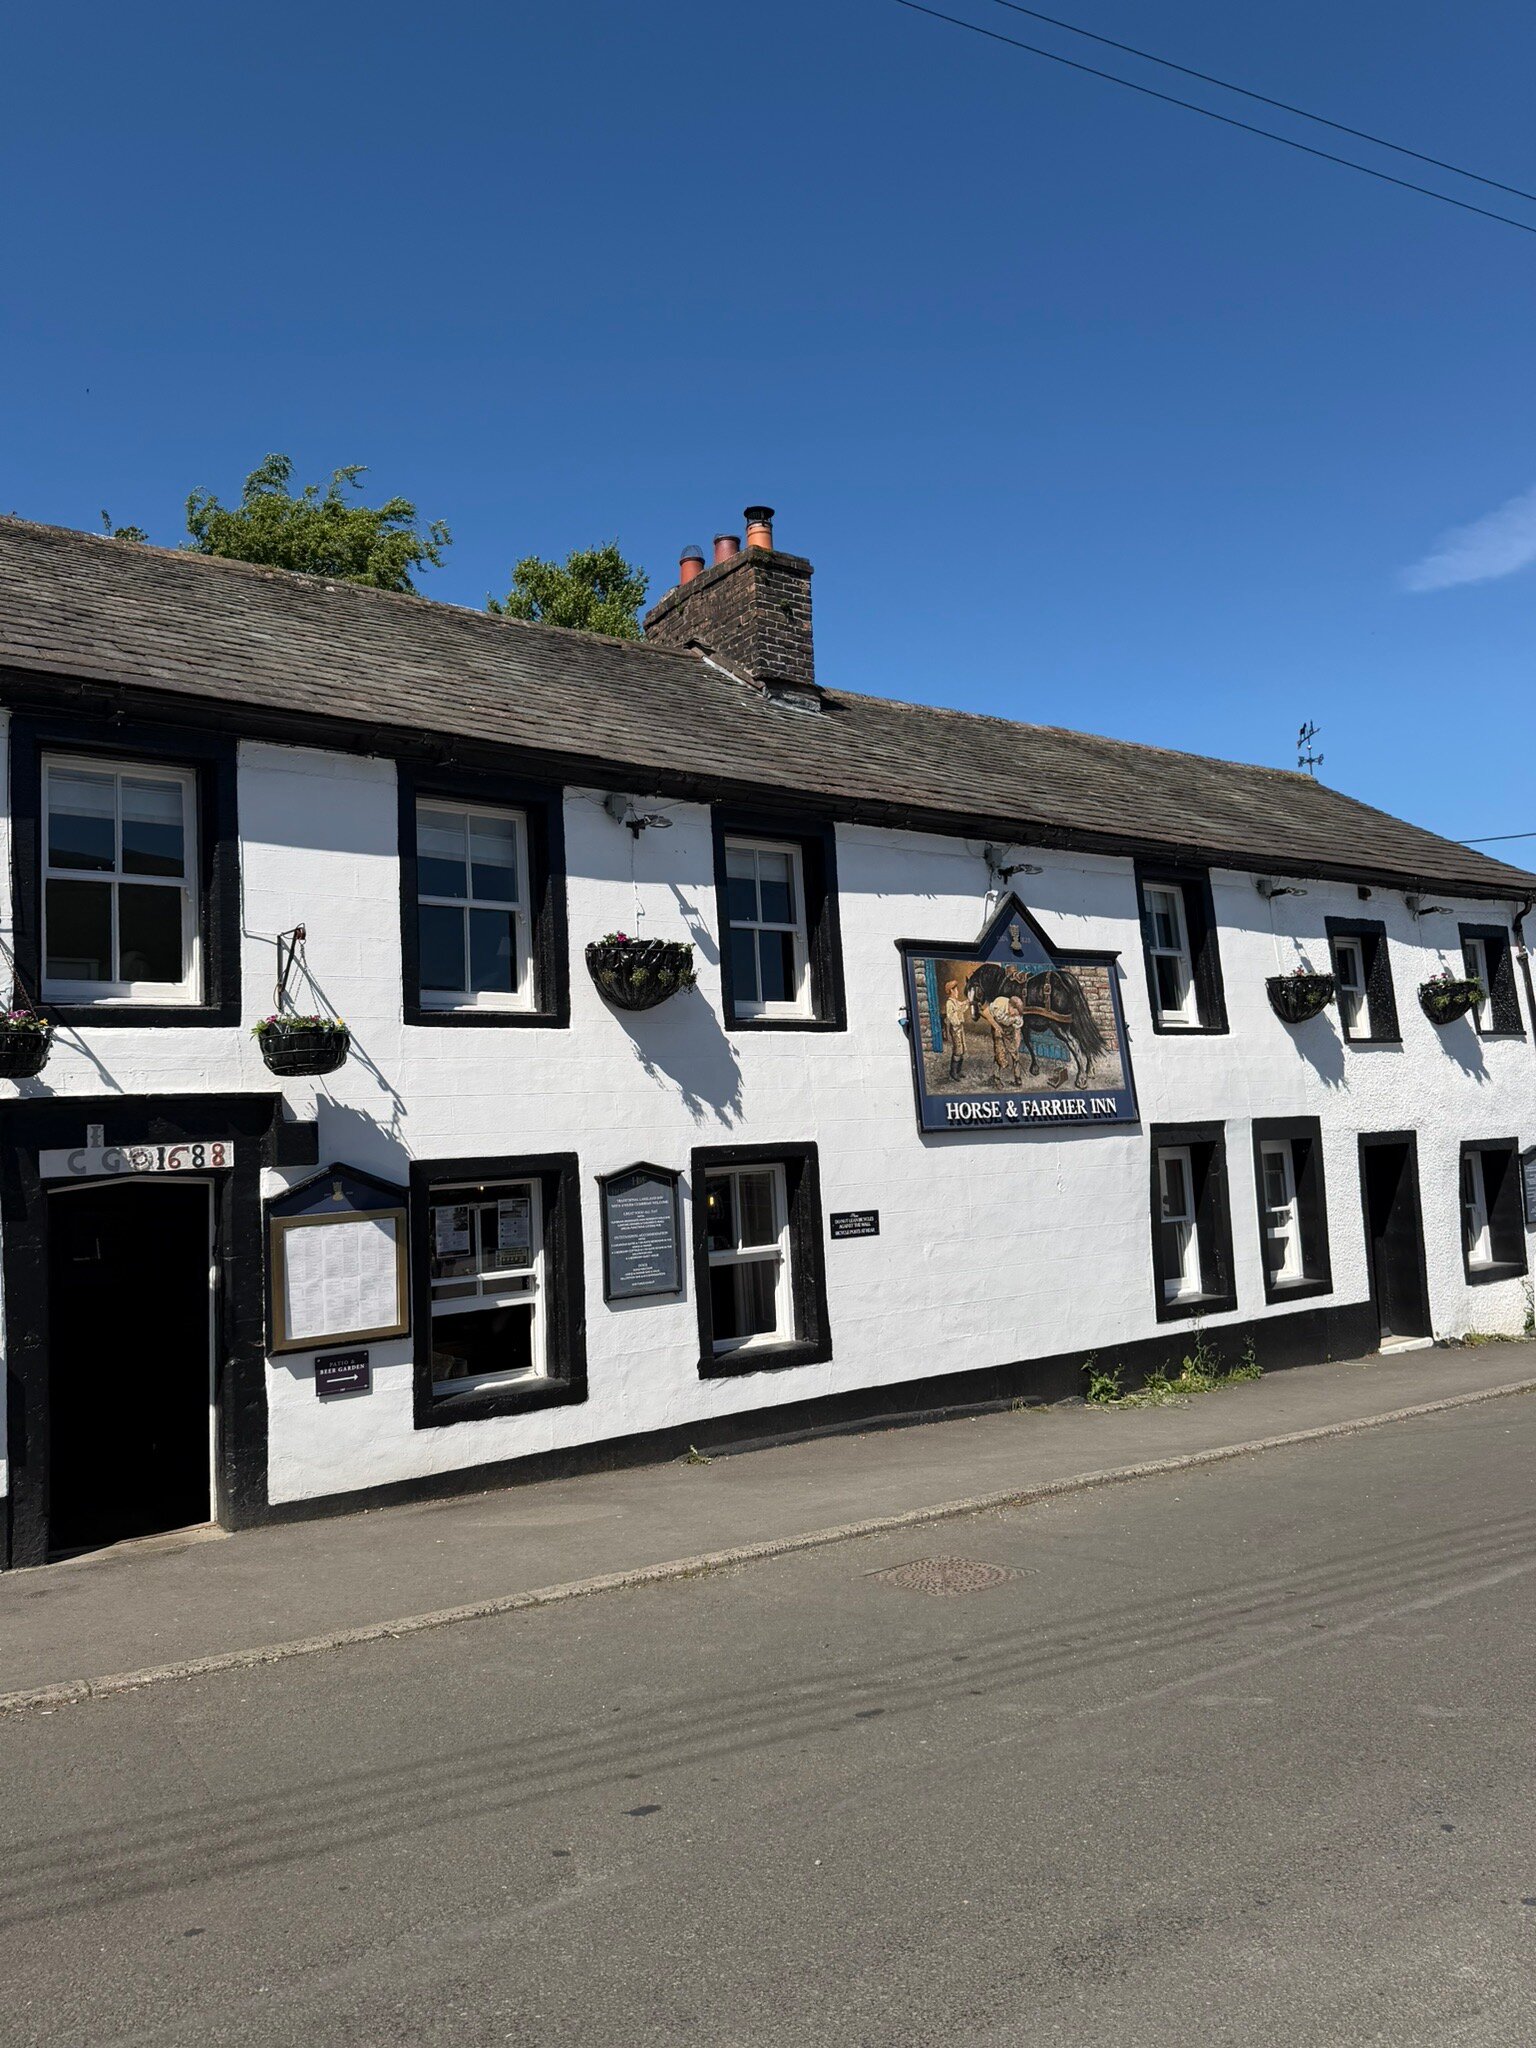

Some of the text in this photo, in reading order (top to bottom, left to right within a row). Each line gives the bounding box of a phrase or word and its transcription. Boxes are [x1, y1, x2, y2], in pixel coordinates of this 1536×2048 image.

[946, 1097, 1117, 1120] HORSE & FARRIER INN
[67, 1142, 226, 1175] C G 1688
[338, 1363, 365, 1372] GARDEN
